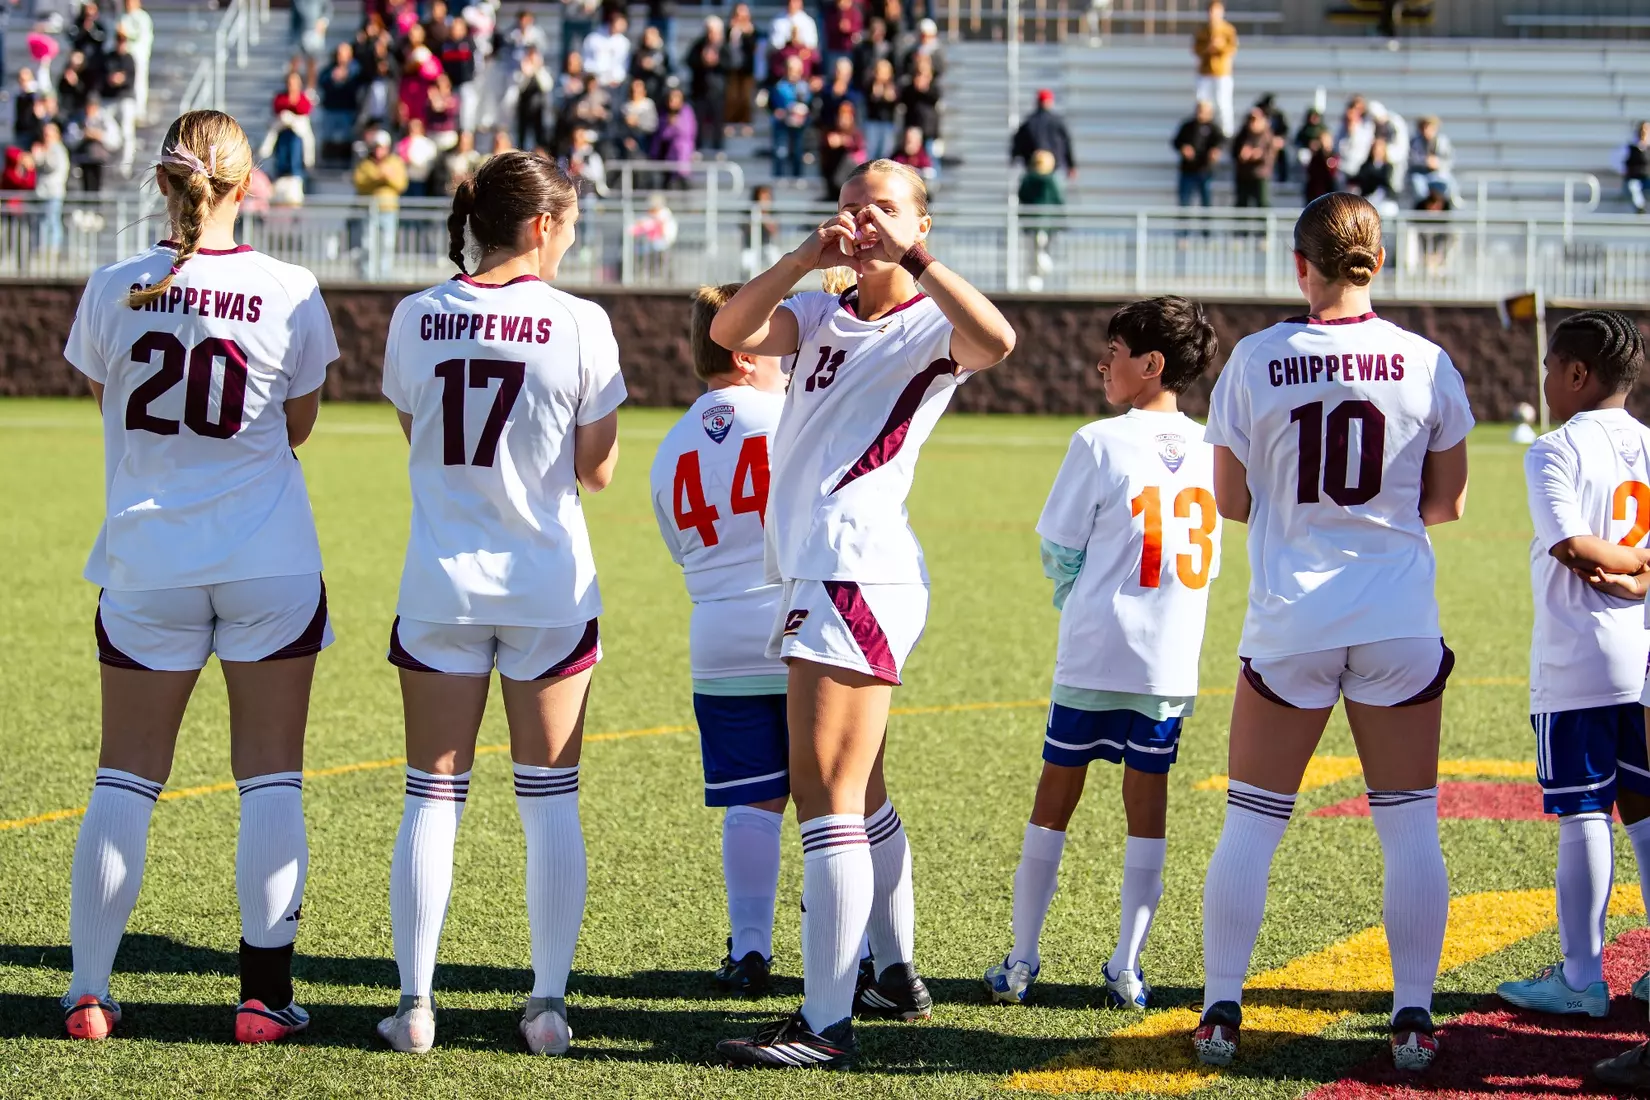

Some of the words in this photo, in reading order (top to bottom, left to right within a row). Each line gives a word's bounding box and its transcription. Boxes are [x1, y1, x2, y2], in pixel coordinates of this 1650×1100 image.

[420, 313, 553, 344] CHIPPEWAS
[805, 345, 848, 393] 13
[1268, 353, 1405, 387] CHIPPEWAS
[126, 331, 248, 439] 20
[434, 359, 526, 468] 17
[673, 435, 771, 548] 44
[1290, 400, 1386, 507] 10
[1131, 486, 1217, 589] 13
[1566, 1000, 1583, 1009] DSG
